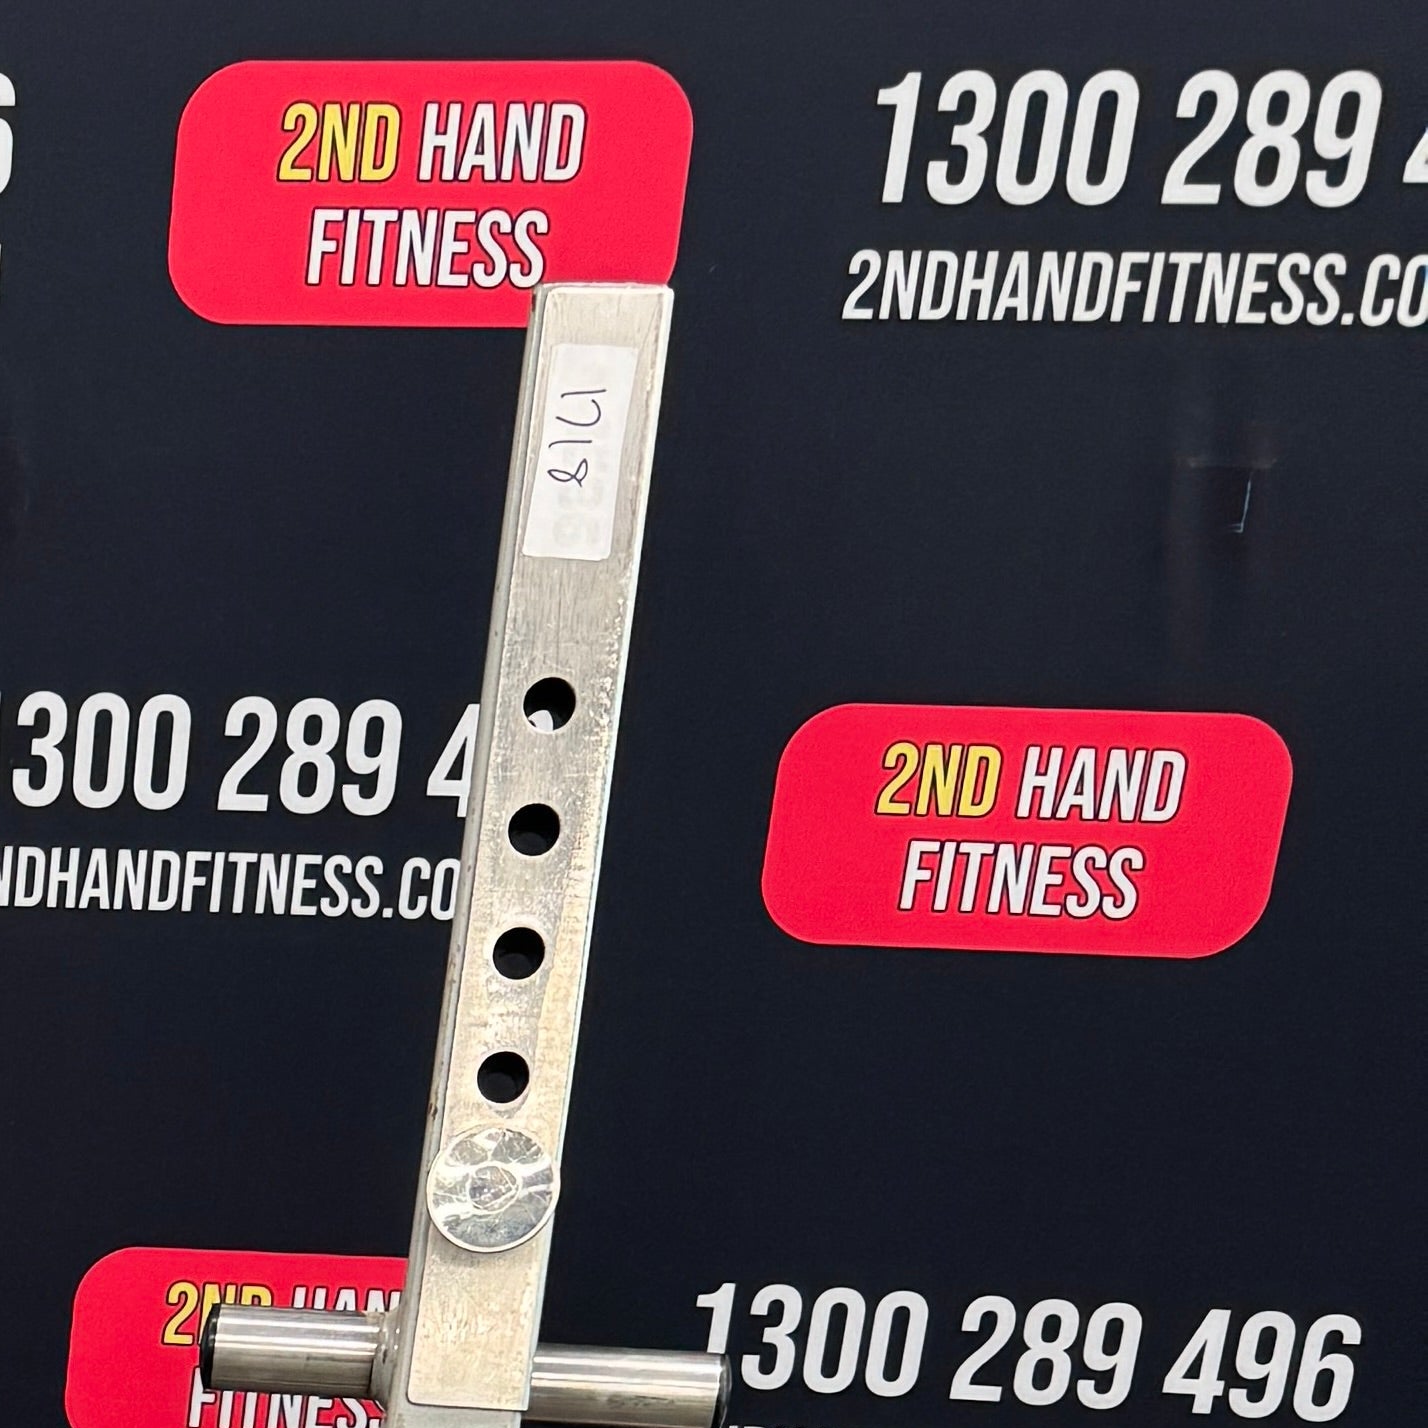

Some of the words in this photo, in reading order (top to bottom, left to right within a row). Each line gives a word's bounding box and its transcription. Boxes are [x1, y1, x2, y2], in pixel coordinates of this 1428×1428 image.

[277, 101, 401, 182] 2ND
[418, 102, 586, 182] HAND
[875, 68, 1141, 207] 1300
[1159, 68, 1384, 209] 289
[302, 207, 550, 288] FITNESS
[546, 388, 607, 488] 1718
[216, 694, 404, 817] 289
[875, 741, 1003, 818] 2ND
[1015, 745, 1187, 823] HAND
[899, 839, 1145, 920] FITNESS
[694, 1282, 930, 1398] 1300
[948, 1294, 1144, 1411] 289
[1160, 1307, 1363, 1424] 496
